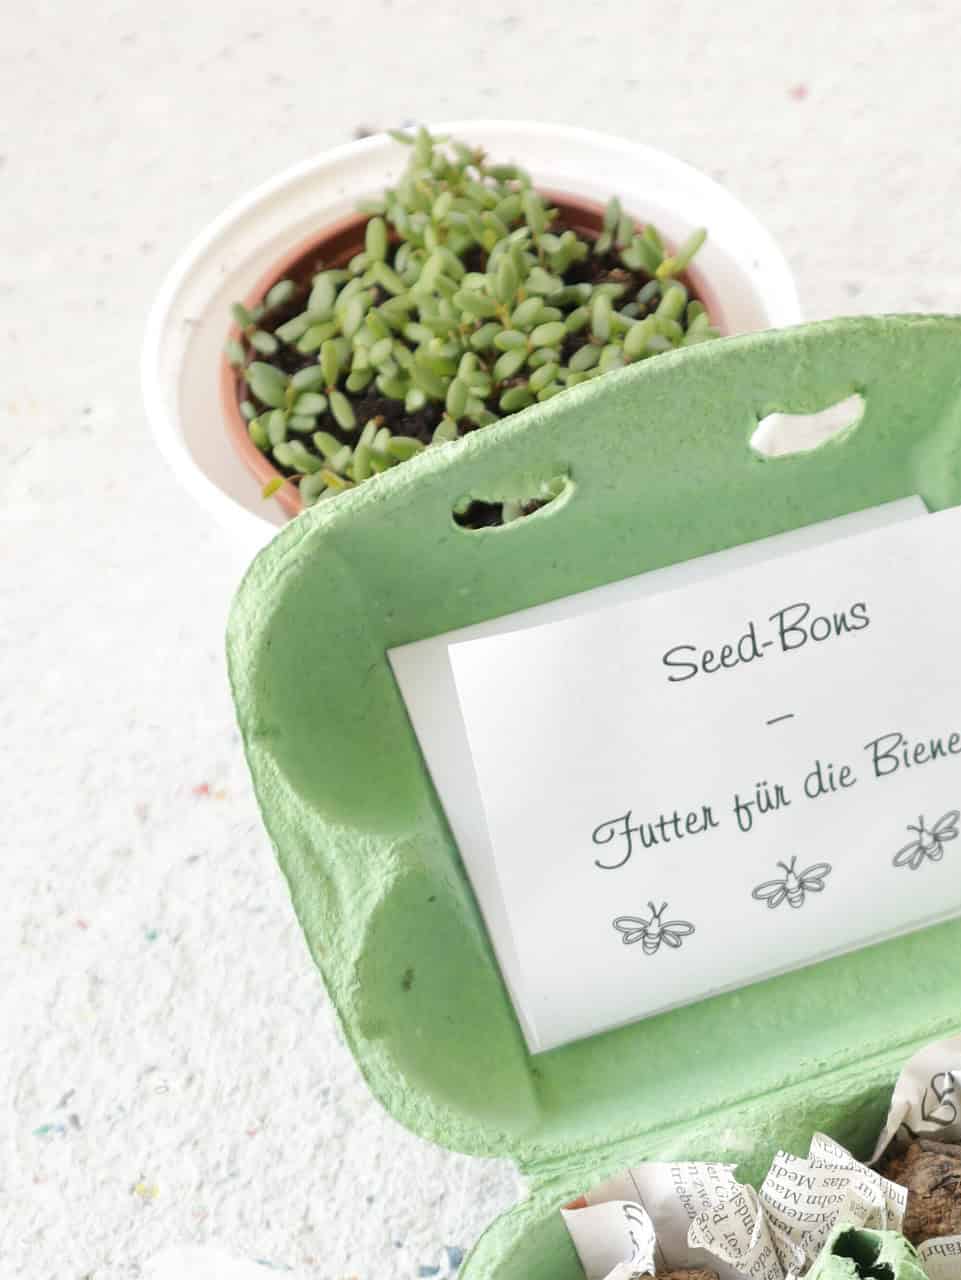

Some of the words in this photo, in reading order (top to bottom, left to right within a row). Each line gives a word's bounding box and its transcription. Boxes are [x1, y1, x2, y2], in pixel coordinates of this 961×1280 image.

[662, 599, 869, 682] Seed-Bons
[592, 807, 719, 870] Futter
[734, 781, 791, 833] für
[804, 759, 856, 800] die
